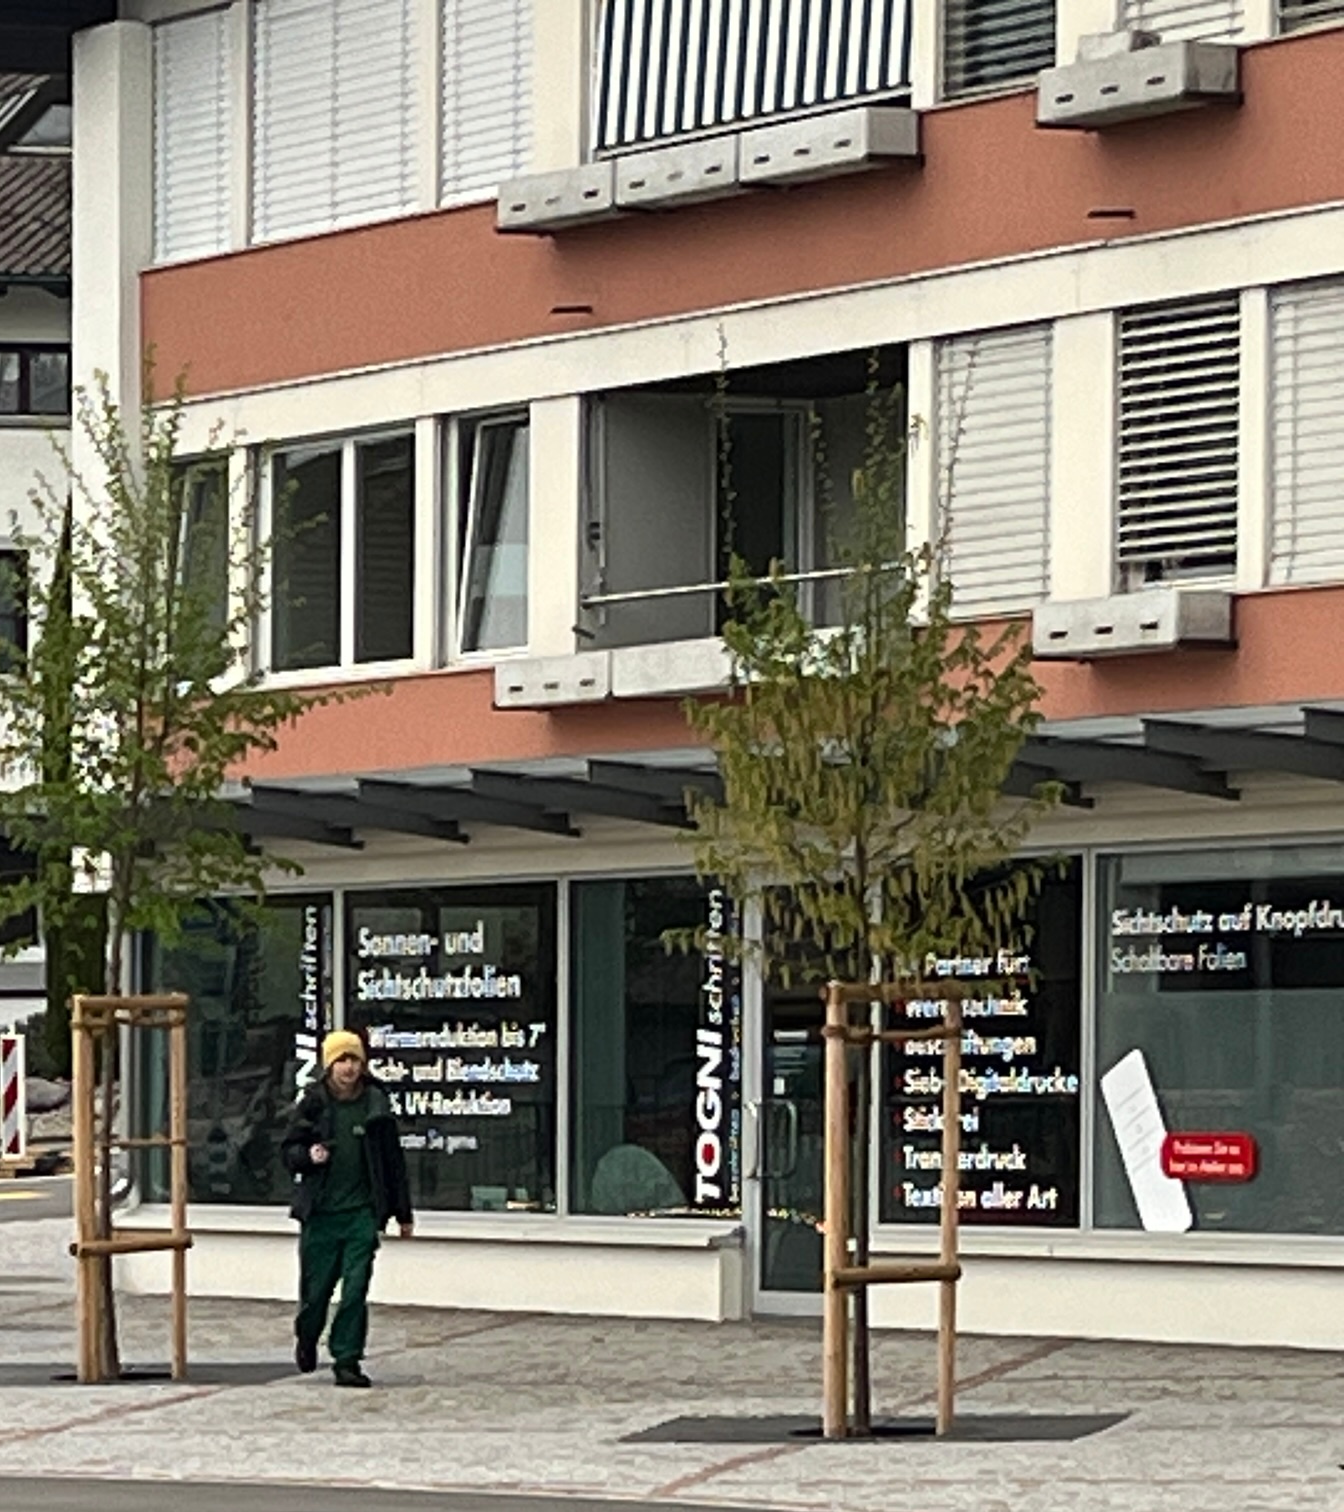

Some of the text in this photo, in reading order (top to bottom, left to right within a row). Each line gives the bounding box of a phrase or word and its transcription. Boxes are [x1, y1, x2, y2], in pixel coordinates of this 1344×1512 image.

[1112, 905, 1213, 936] Sichtschutz
[1218, 902, 1254, 931] auf
[358, 920, 484, 957] Sonnen- und
[925, 952, 993, 976] Partner
[1112, 942, 1247, 973] Schaltbare Folien
[358, 964, 521, 1000] Sichtschutzfolien
[905, 990, 1029, 1018] Wertechnik
[501, 1020, 526, 1048] bis
[905, 1029, 1037, 1062] Besciftungen
[412, 1056, 443, 1082] und
[957, 1066, 1079, 1100] Digitaldrucke
[404, 1088, 511, 1116] UV-Reduktion
[695, 1028, 723, 1204] TOGNI
[903, 1105, 979, 1132] Stickei
[903, 1143, 1026, 1170] Tranerdruck
[903, 1181, 1058, 1209] Textien aller Art
